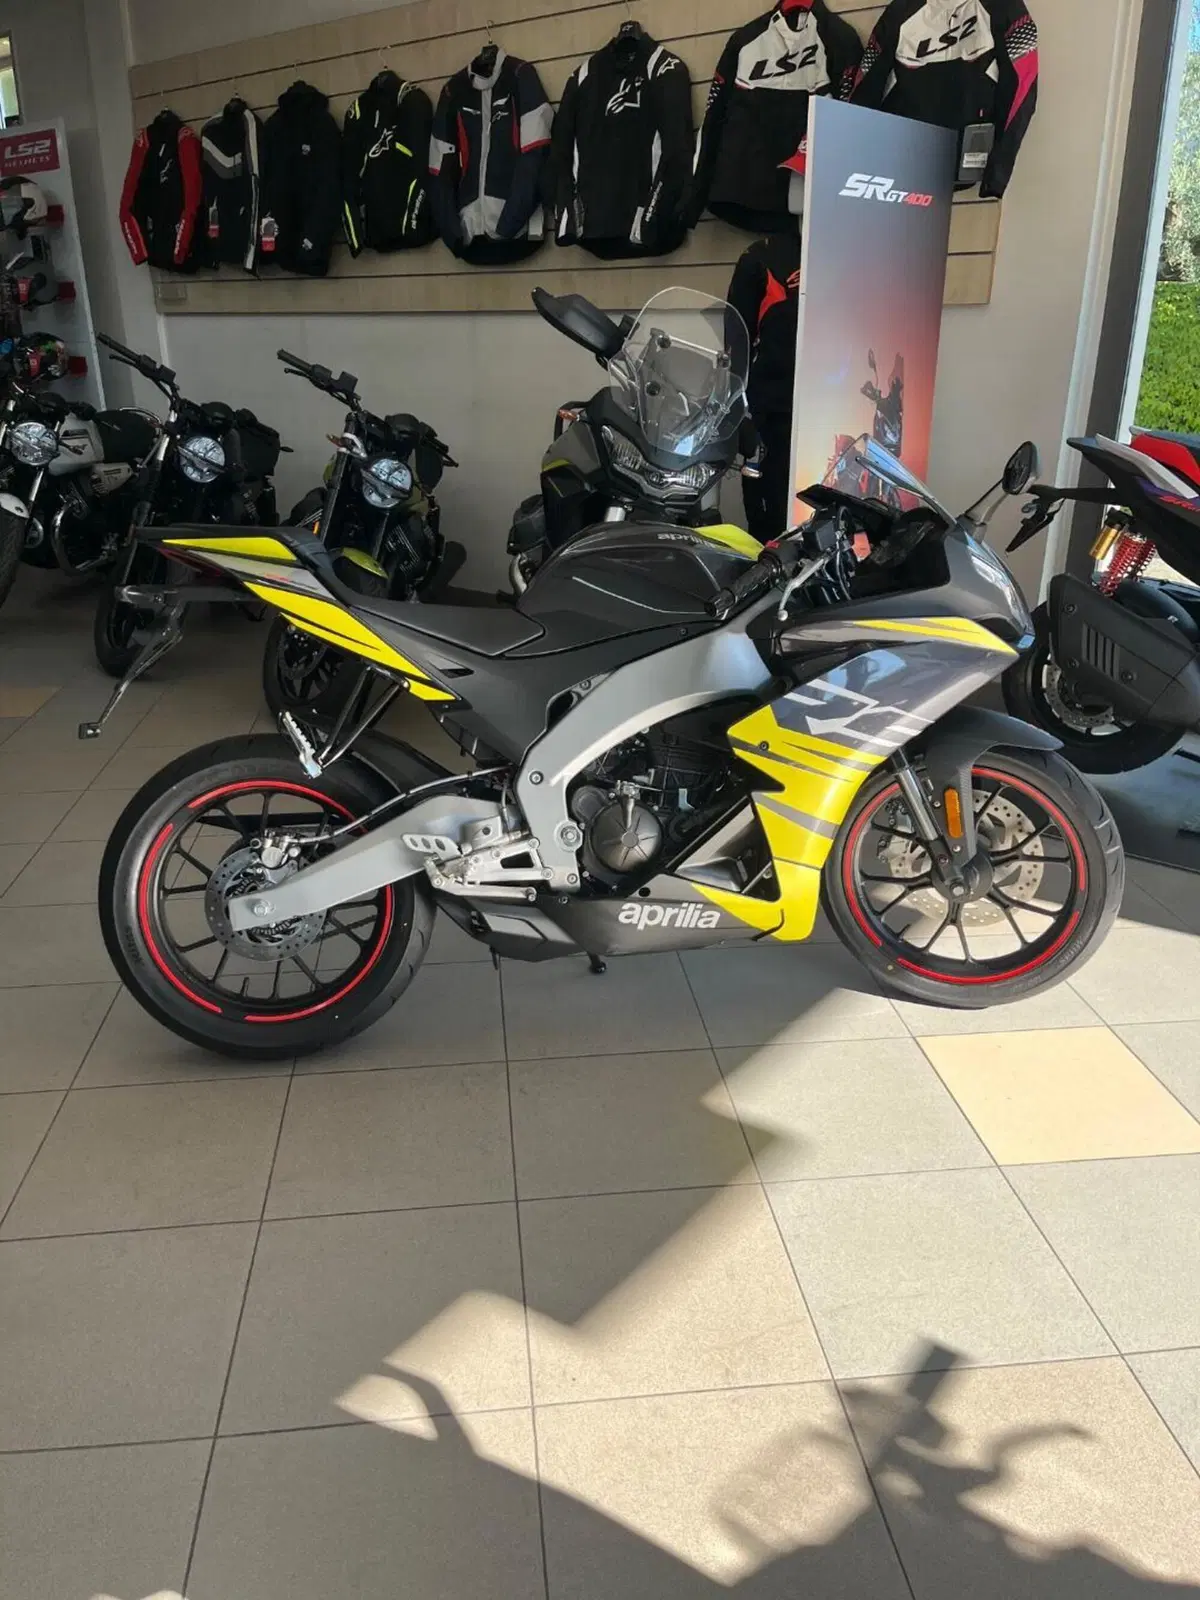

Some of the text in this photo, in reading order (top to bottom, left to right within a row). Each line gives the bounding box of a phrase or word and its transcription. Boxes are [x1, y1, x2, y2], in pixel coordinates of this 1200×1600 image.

[916, 16, 978, 58] LS2
[749, 44, 819, 81] LS2
[4, 138, 51, 159] LS2
[618, 902, 721, 931] aprilia
